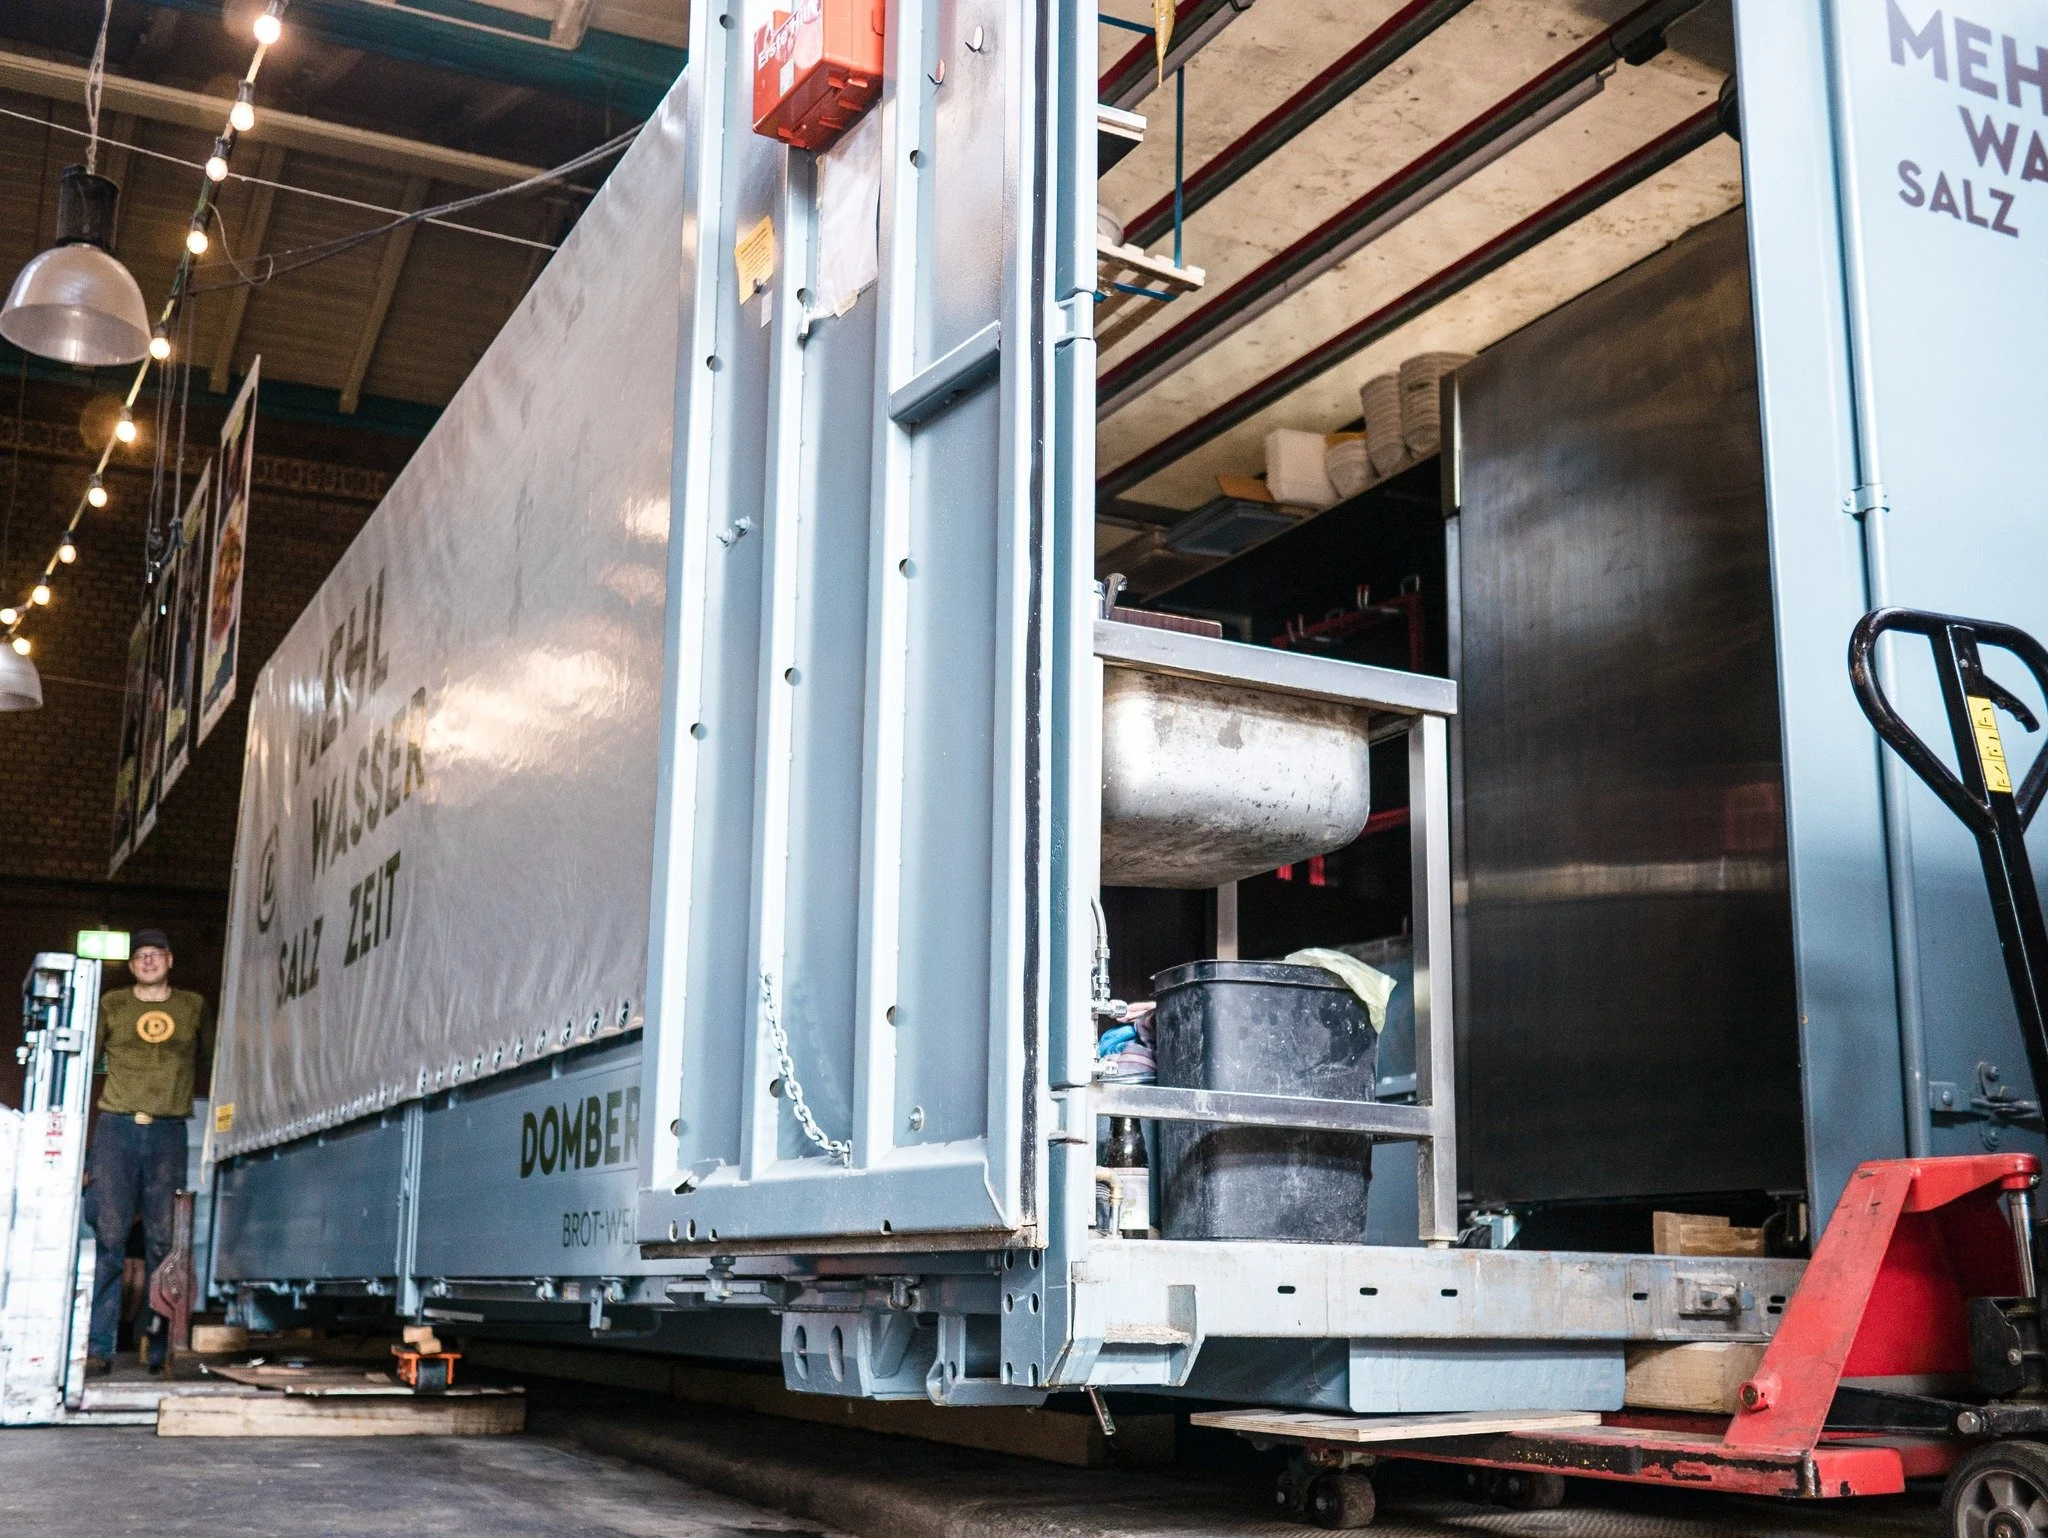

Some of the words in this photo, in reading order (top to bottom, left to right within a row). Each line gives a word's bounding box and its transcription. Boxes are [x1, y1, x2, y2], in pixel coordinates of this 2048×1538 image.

[1957, 105, 2048, 183] WA
[1898, 159, 2018, 238] SALZ
[312, 686, 426, 881] WASSER
[276, 915, 323, 1009] SALZ
[344, 850, 401, 967] ZEIT
[520, 1086, 641, 1179] DOMBER
